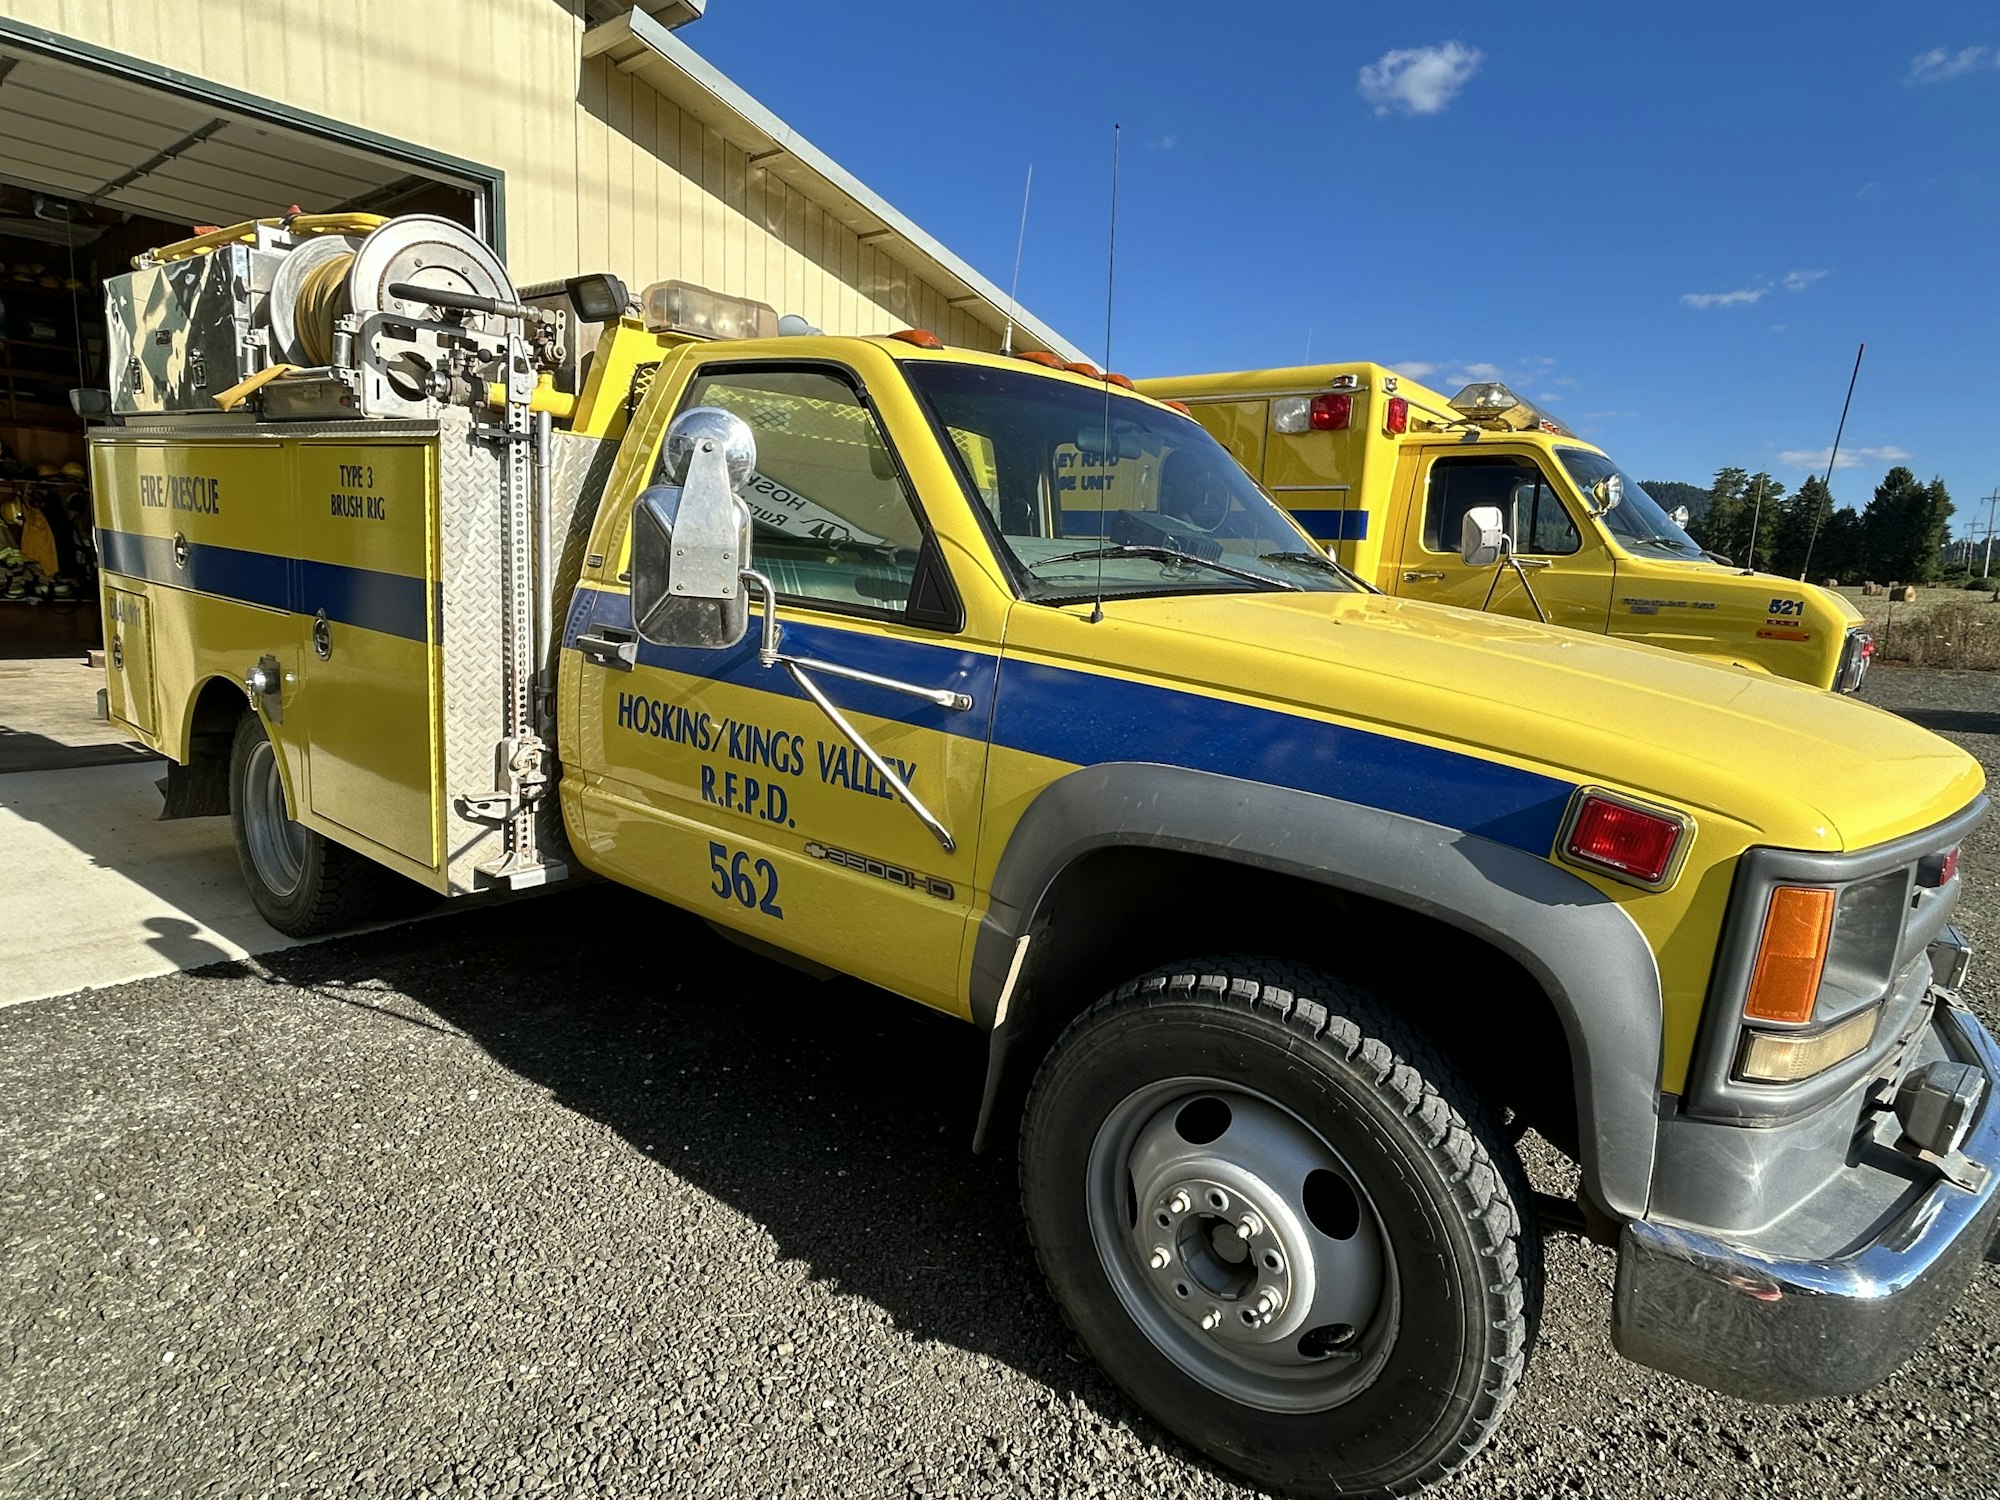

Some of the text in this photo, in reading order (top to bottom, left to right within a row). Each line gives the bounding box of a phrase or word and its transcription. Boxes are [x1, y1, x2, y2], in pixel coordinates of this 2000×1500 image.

[140, 475, 219, 514] FIRE/RESCUE
[339, 464, 373, 489] TYPE 3
[1081, 475, 1114, 491] UNIT
[331, 494, 386, 521] BRUSH RIG
[1767, 597, 1805, 618] 521
[617, 692, 918, 804] HOSKINS/KINGS VALLEY
[701, 765, 796, 828] R.F.P.D.
[709, 841, 784, 920] 562
[827, 848, 954, 901] 3500HD
